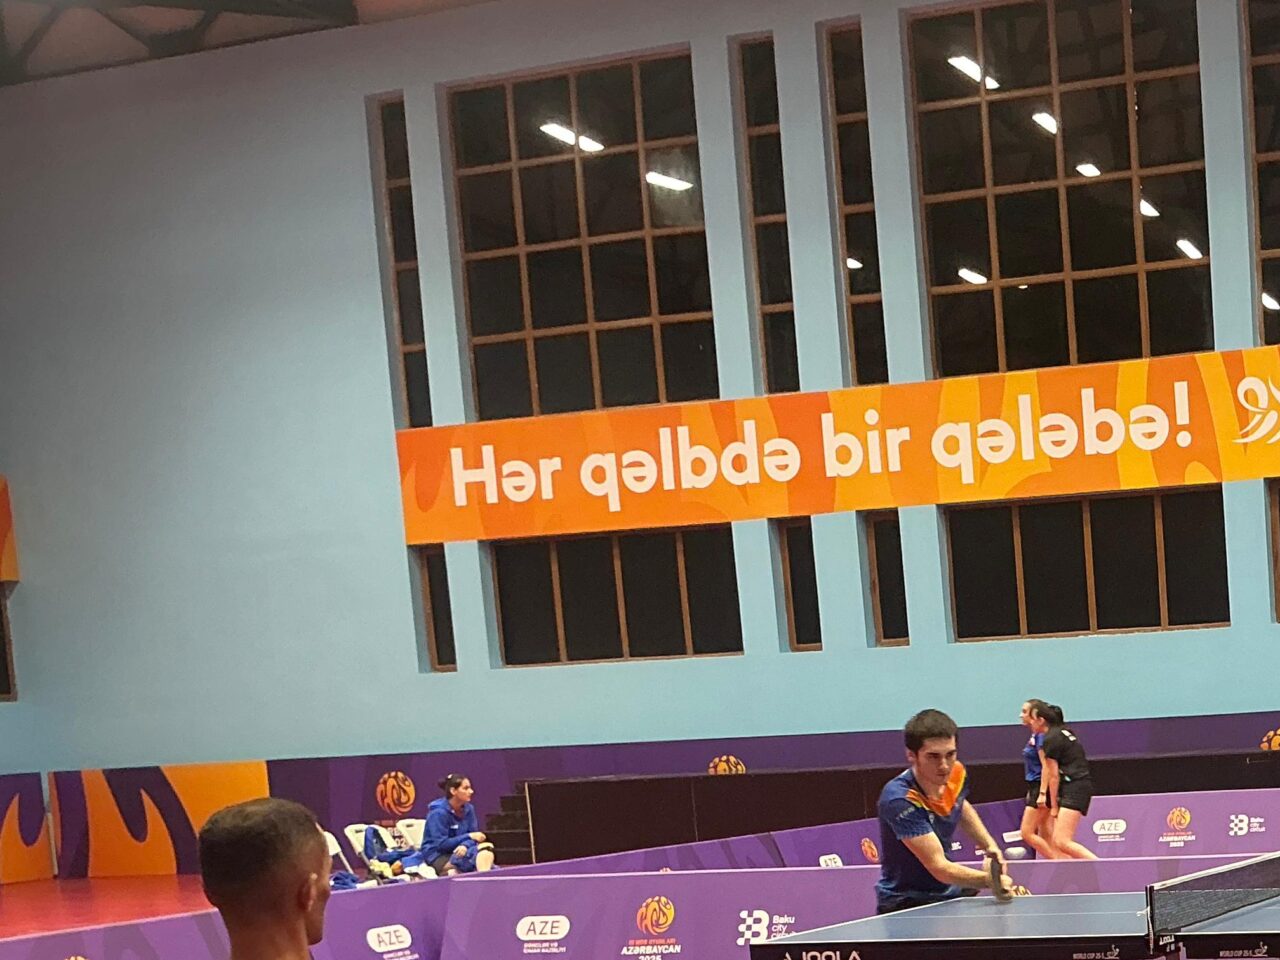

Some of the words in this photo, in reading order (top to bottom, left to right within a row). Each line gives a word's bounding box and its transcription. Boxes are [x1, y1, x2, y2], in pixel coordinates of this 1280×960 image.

[450, 444, 562, 507] Hər
[580, 419, 801, 513] qəlbdə
[820, 408, 910, 479] bir
[930, 381, 1192, 485] qələbə!
[772, 914, 796, 924] Baku
[525, 920, 561, 936] AZE
[376, 929, 405, 948] AZE
